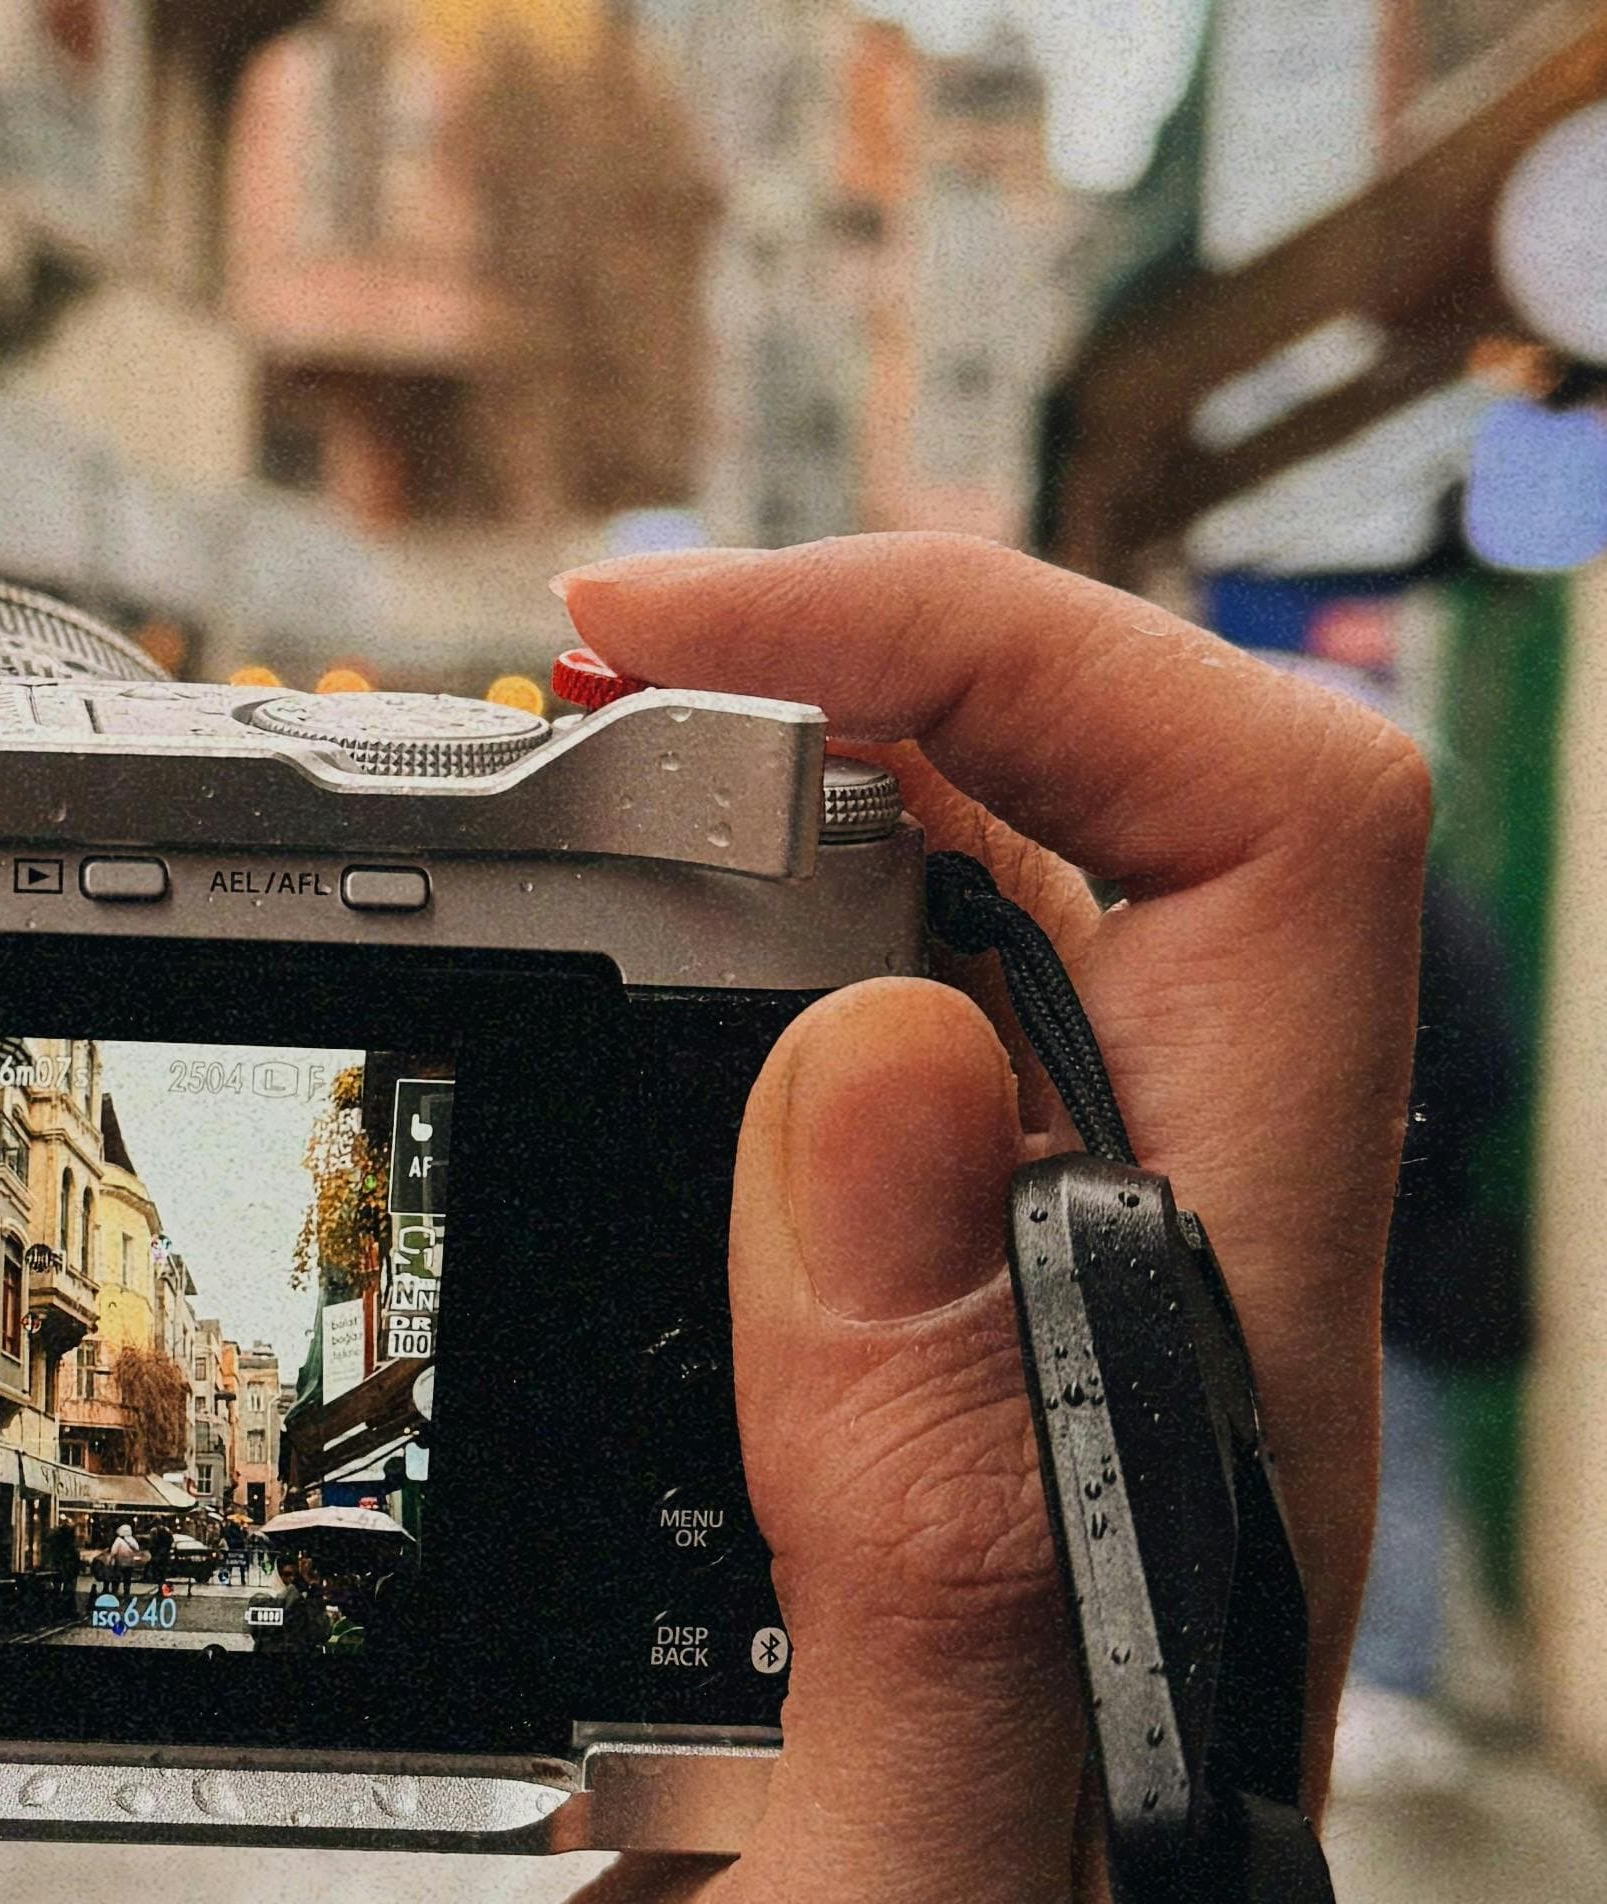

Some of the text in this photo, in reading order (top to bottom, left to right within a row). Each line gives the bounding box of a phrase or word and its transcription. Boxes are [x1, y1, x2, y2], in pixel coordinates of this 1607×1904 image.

[209, 870, 330, 896] AEL/AFL
[168, 1059, 244, 1095] 2504
[408, 1156, 434, 1179] AF
[389, 1315, 432, 1331] DR
[393, 1333, 428, 1354] 100
[660, 1509, 724, 1528] MENU
[675, 1530, 707, 1548] OK
[92, 1596, 177, 1629] ISO 640
[657, 1627, 709, 1647] DISP
[650, 1647, 709, 1668] BACK
